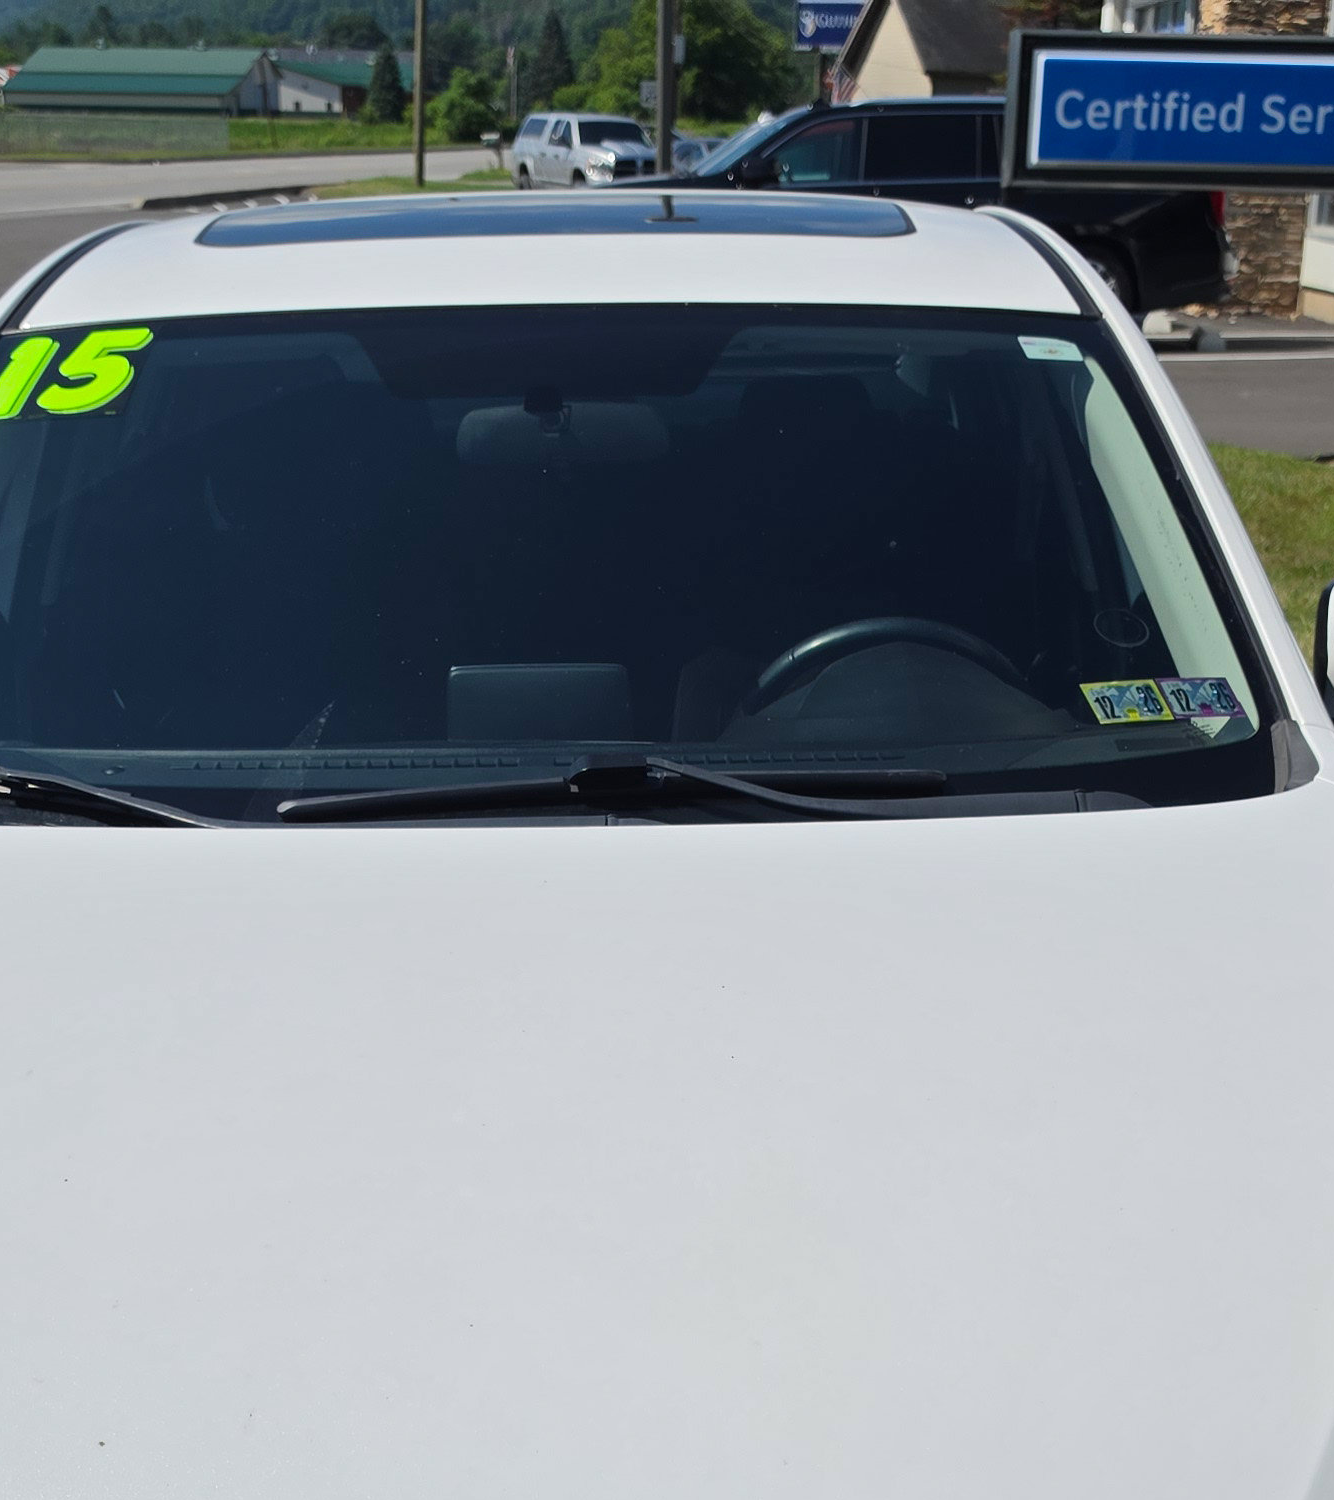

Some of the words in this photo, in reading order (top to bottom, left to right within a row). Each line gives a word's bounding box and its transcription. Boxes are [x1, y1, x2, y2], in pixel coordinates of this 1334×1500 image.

[1054, 88, 1246, 134] Certified
[1093, 695, 1122, 720] 12
[1135, 685, 1165, 714] 26
[1169, 687, 1197, 713] 12
[1208, 681, 1238, 711] 26
